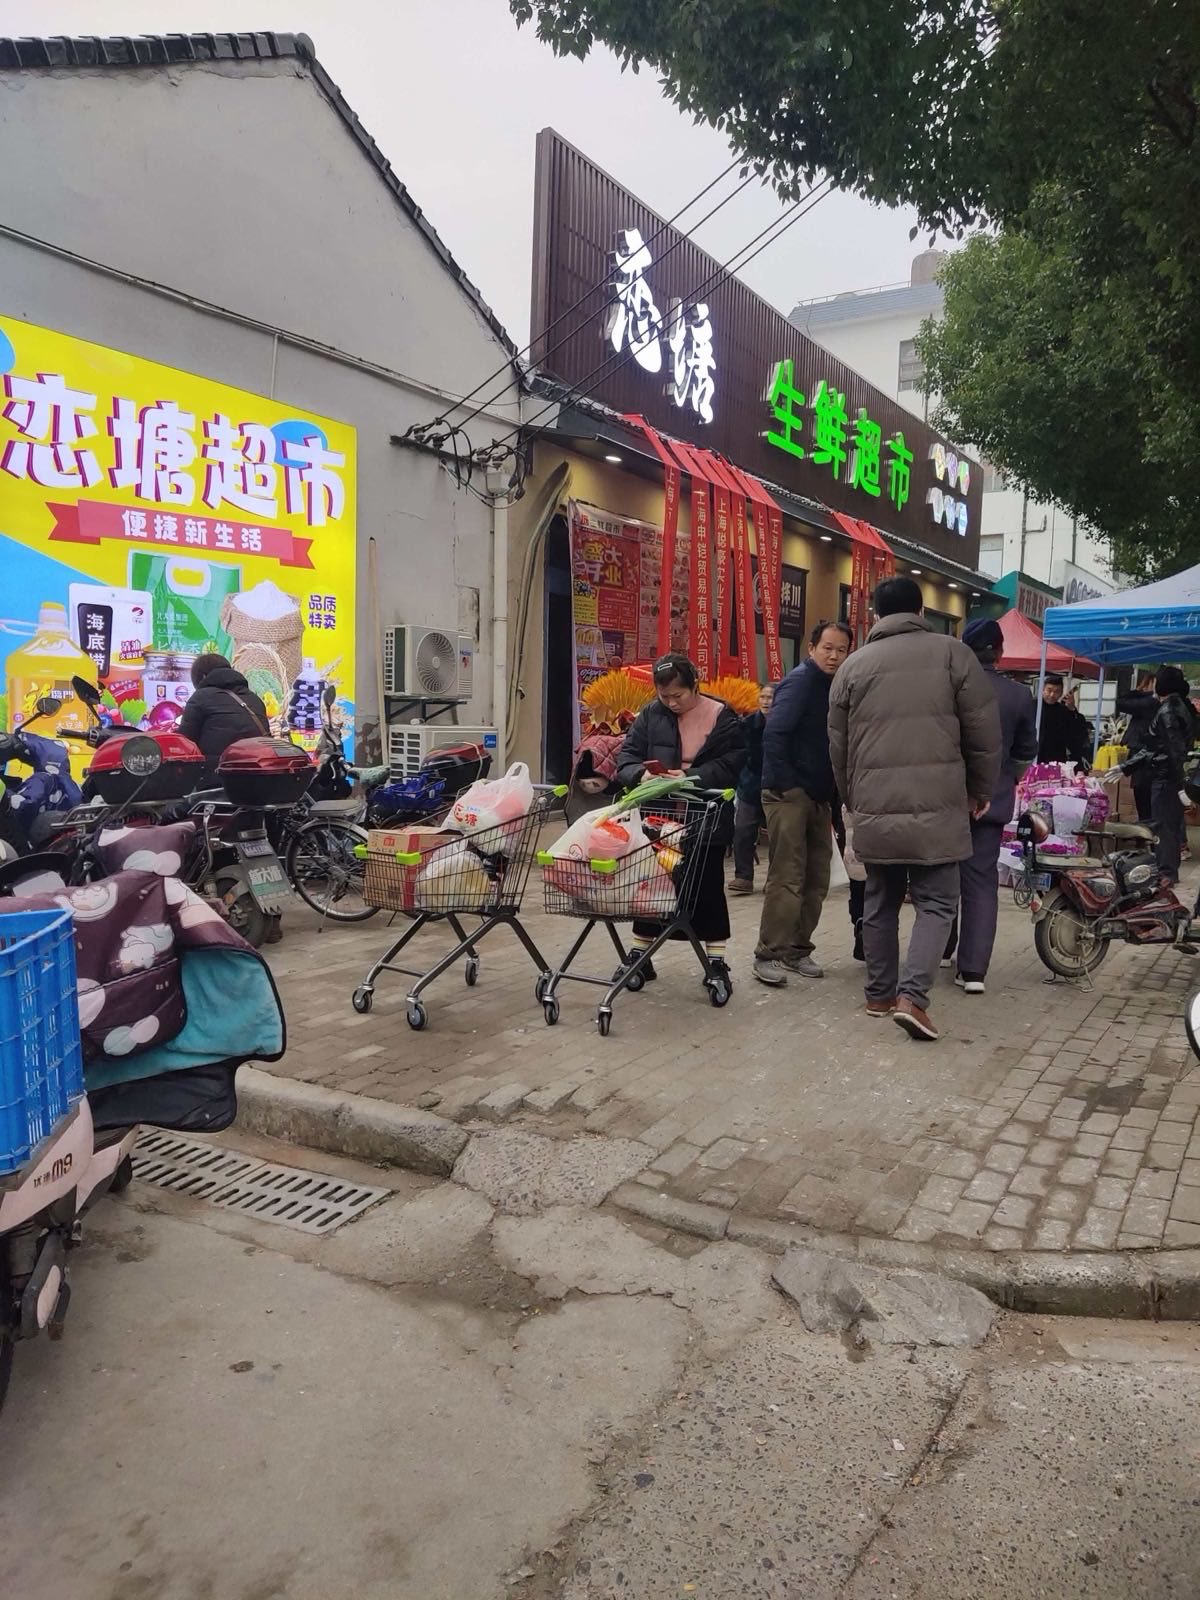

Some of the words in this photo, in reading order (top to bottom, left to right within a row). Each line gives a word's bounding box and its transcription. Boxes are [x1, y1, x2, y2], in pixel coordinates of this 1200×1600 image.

[608, 228, 717, 425] 恋塘
[1, 373, 346, 527] 恋塘超市
[763, 359, 914, 512] 生鲜超市
[122, 509, 263, 552] 便捷新生活
[308, 594, 337, 613] 品质
[308, 611, 337, 631] 特卖
